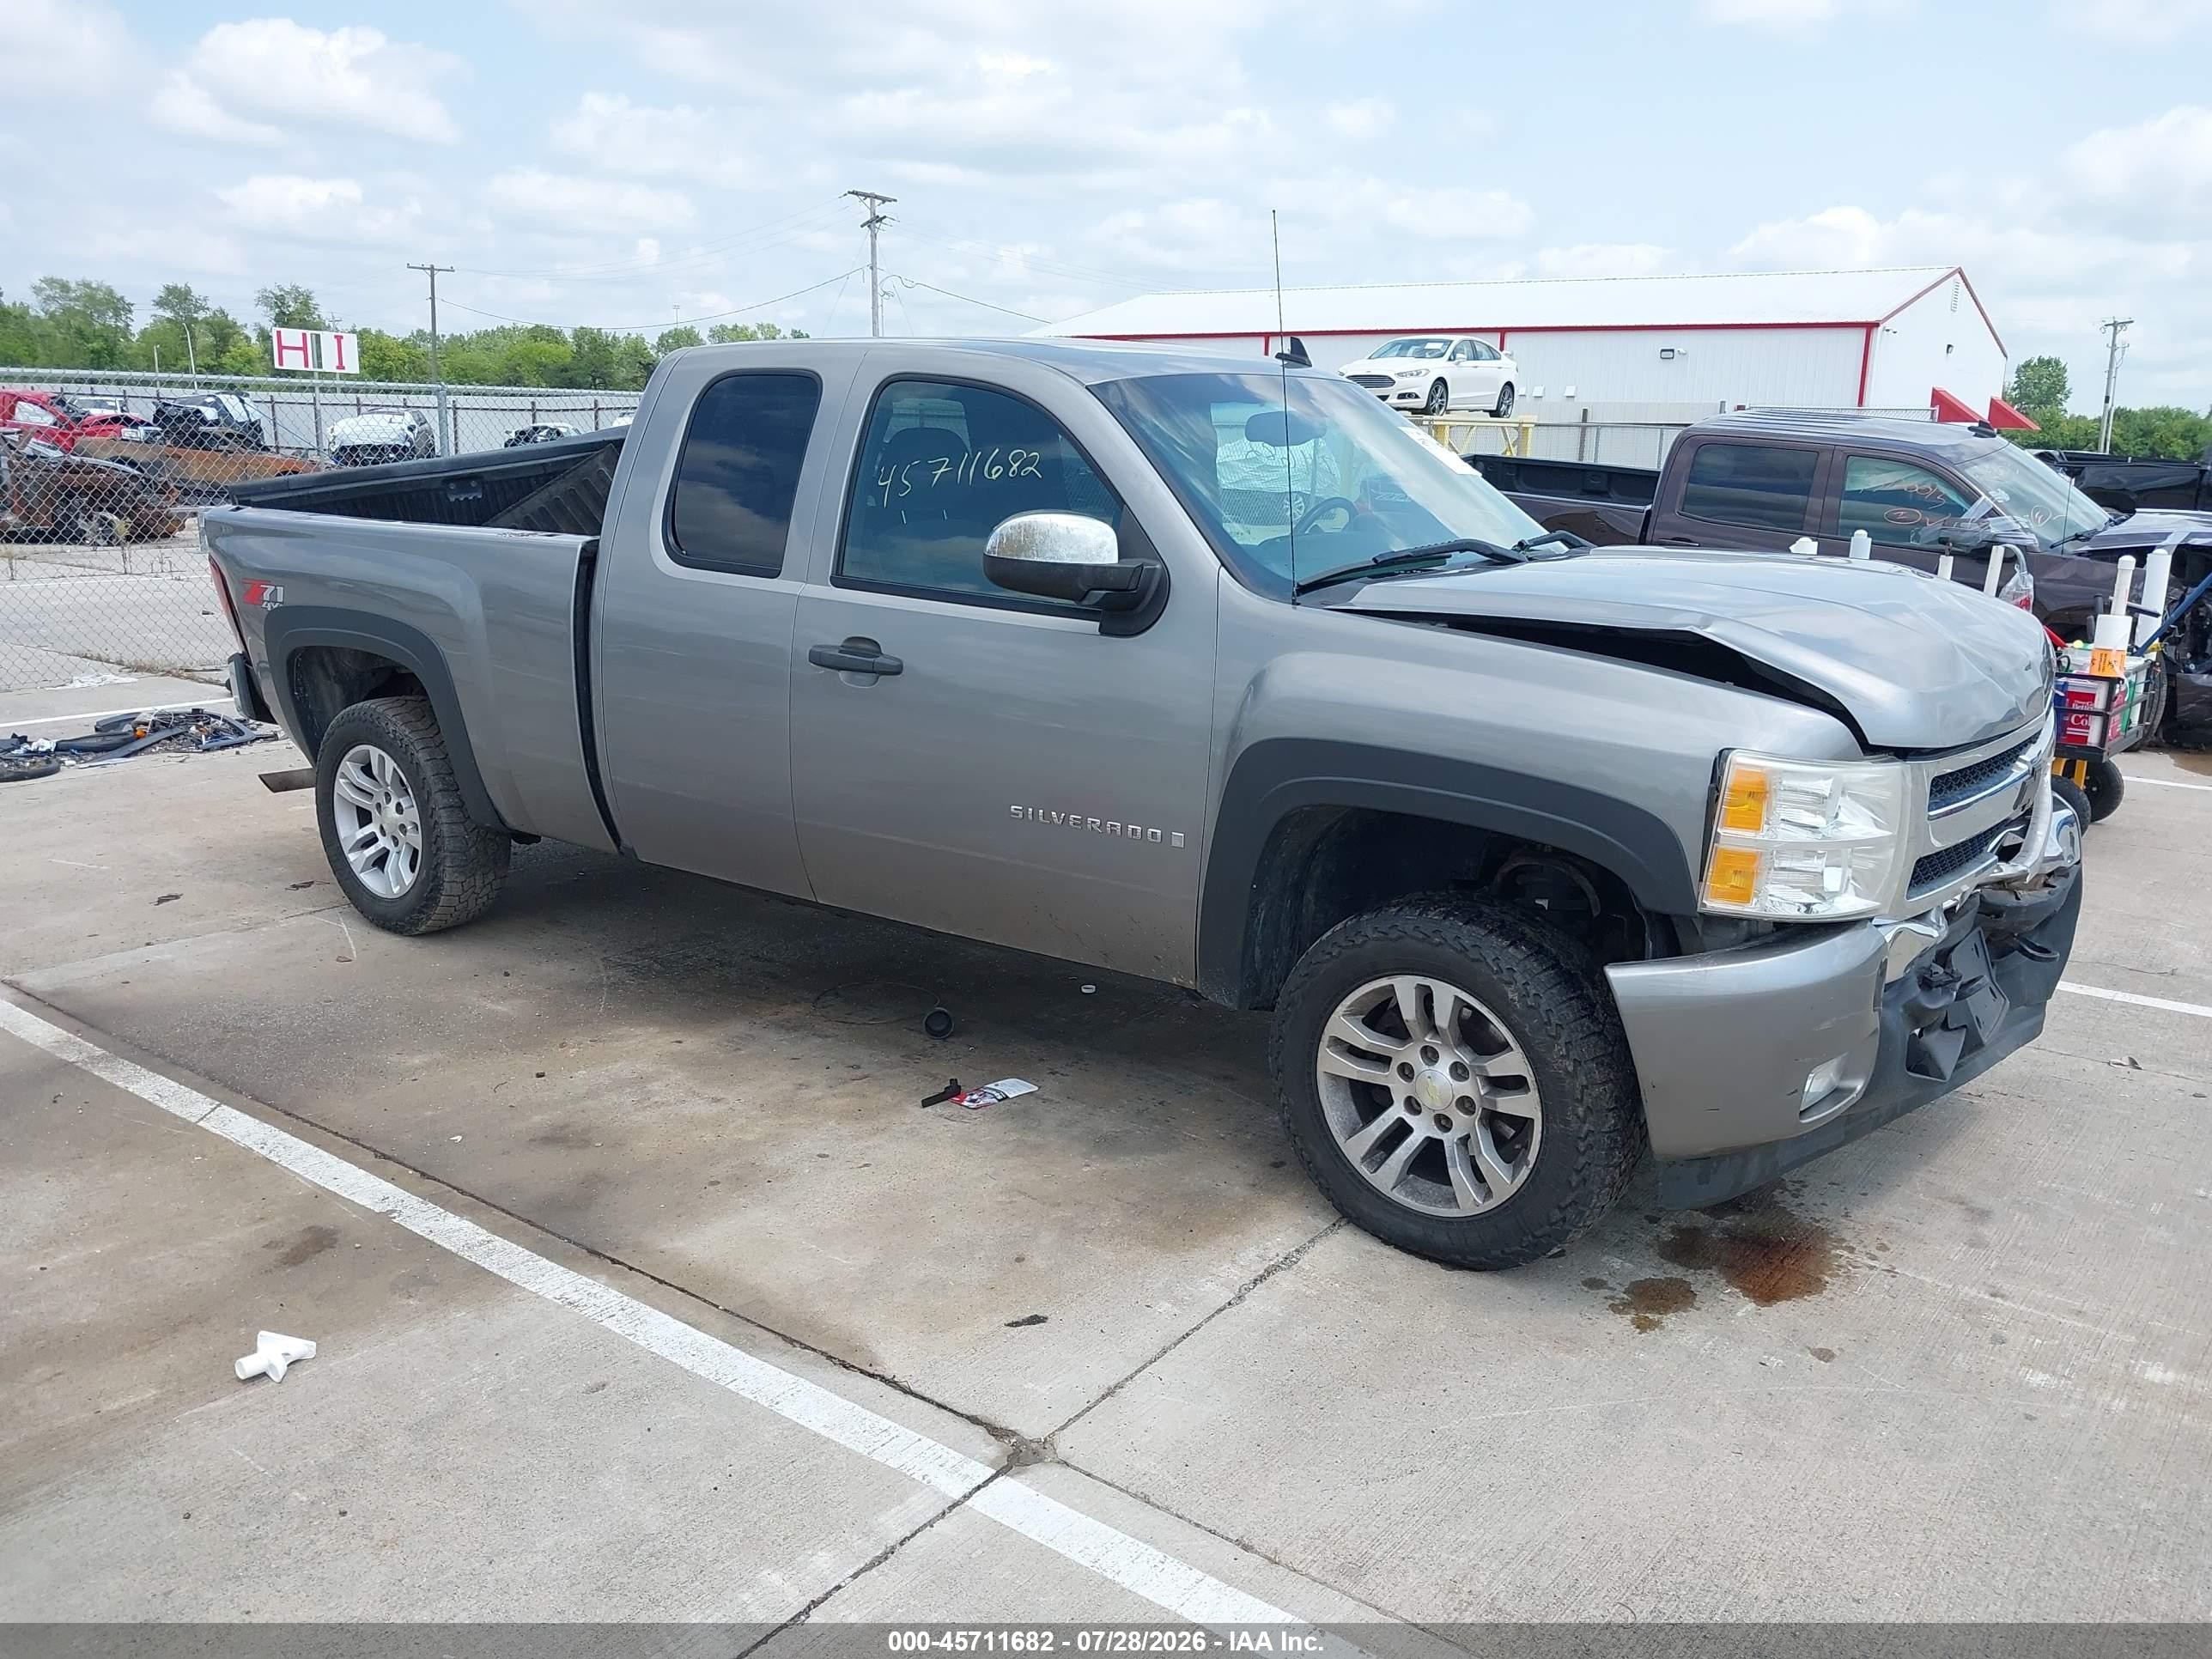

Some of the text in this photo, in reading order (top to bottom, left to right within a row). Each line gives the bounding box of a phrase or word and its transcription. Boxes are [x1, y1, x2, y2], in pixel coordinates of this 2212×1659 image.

[878, 447, 1042, 508] 45711682
[241, 577, 284, 605] Z71
[1010, 805, 1162, 843] SILVERADO
